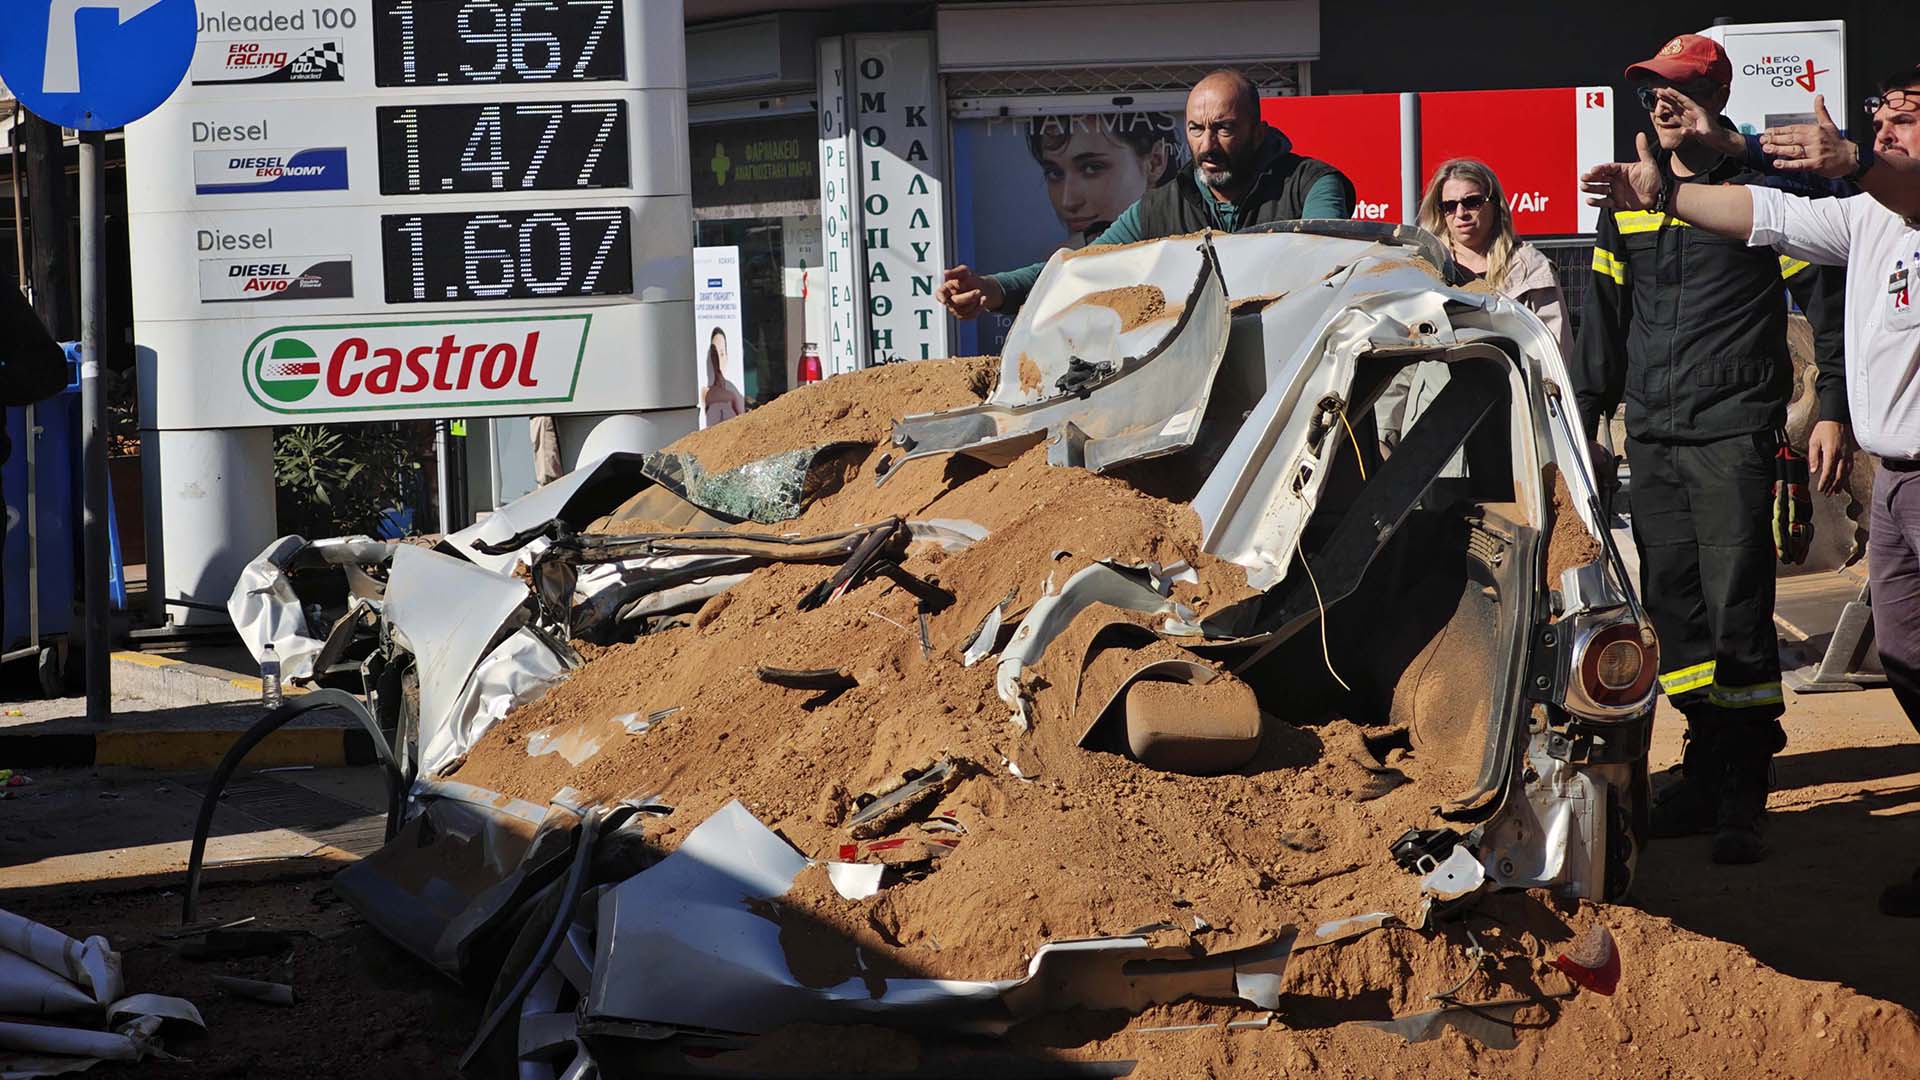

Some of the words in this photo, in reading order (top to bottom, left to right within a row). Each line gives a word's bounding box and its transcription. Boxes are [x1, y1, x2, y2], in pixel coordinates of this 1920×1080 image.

[312, 8, 356, 29] 100
[229, 43, 260, 53] EKO
[389, 0, 614, 82] 1.967
[225, 52, 288, 68] racing
[1773, 55, 1800, 63] EKO
[291, 62, 312, 73] 100
[1743, 64, 1802, 76] Charge
[1771, 76, 1794, 87] Go
[192, 120, 268, 142] Diesel
[393, 103, 618, 190] 1.477
[229, 157, 284, 169] DIESEL
[256, 166, 325, 177] EKONOMY
[197, 228, 272, 251] Diesel
[398, 211, 622, 298] 1.607
[229, 263, 290, 277] DIESEL
[326, 330, 540, 397] Castrol
